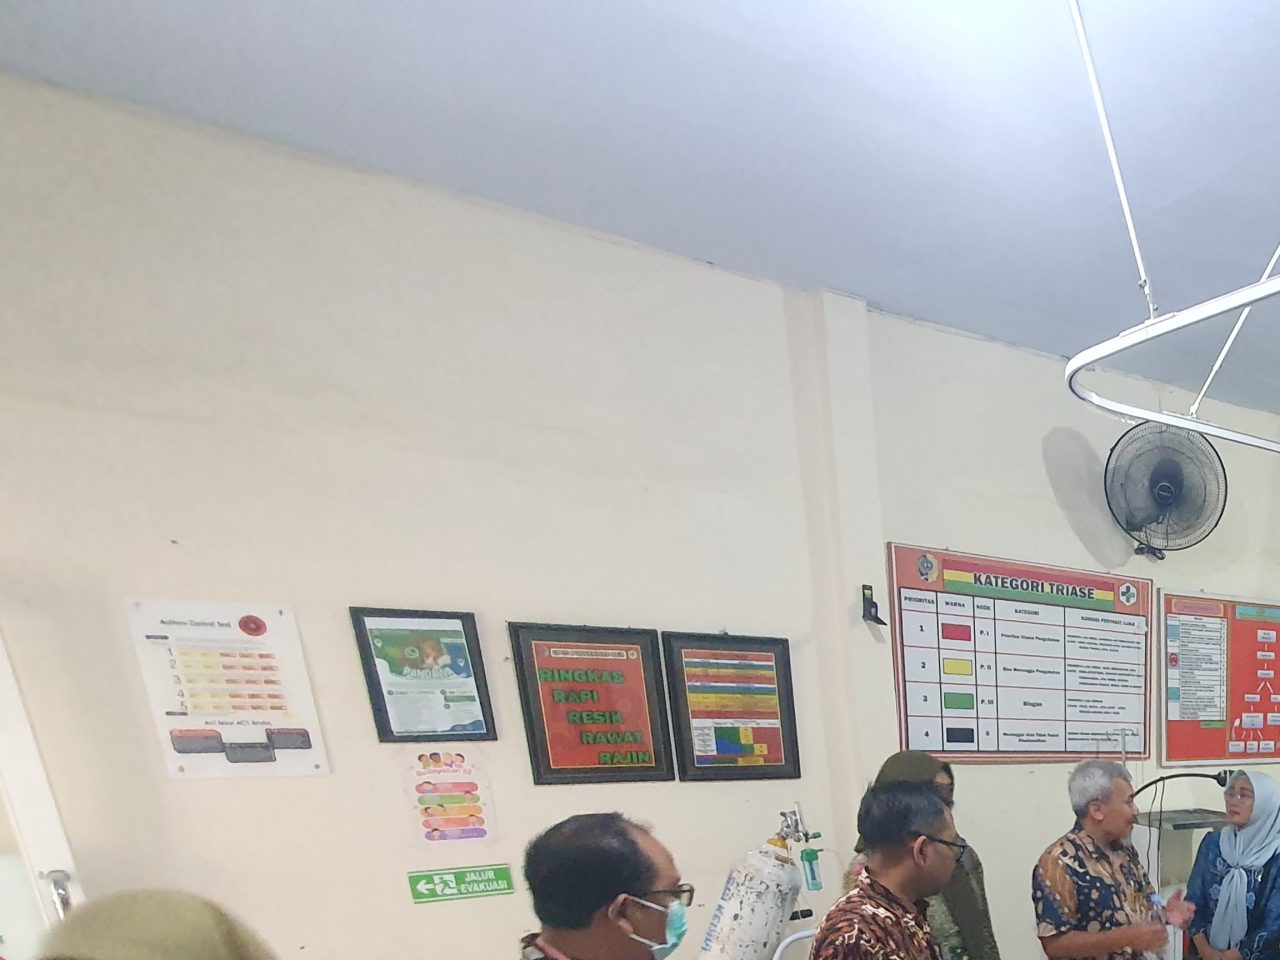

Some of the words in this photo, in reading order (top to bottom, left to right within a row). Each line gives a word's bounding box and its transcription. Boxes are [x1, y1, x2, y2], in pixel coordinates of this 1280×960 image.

[973, 572, 1045, 594] KATEGORI
[1049, 582, 1096, 600] TRIASE
[903, 596, 935, 605] PRIORITAS
[945, 600, 966, 609] WARNA
[537, 668, 625, 684] RINGKAS
[552, 688, 599, 704] RAPI
[567, 710, 624, 724] RESIK
[580, 730, 643, 744] RAWAT
[924, 730, 930, 738] 4
[598, 750, 652, 764] RAJIN
[464, 870, 496, 882] JALUR
[460, 880, 509, 893] EVAKUASI
